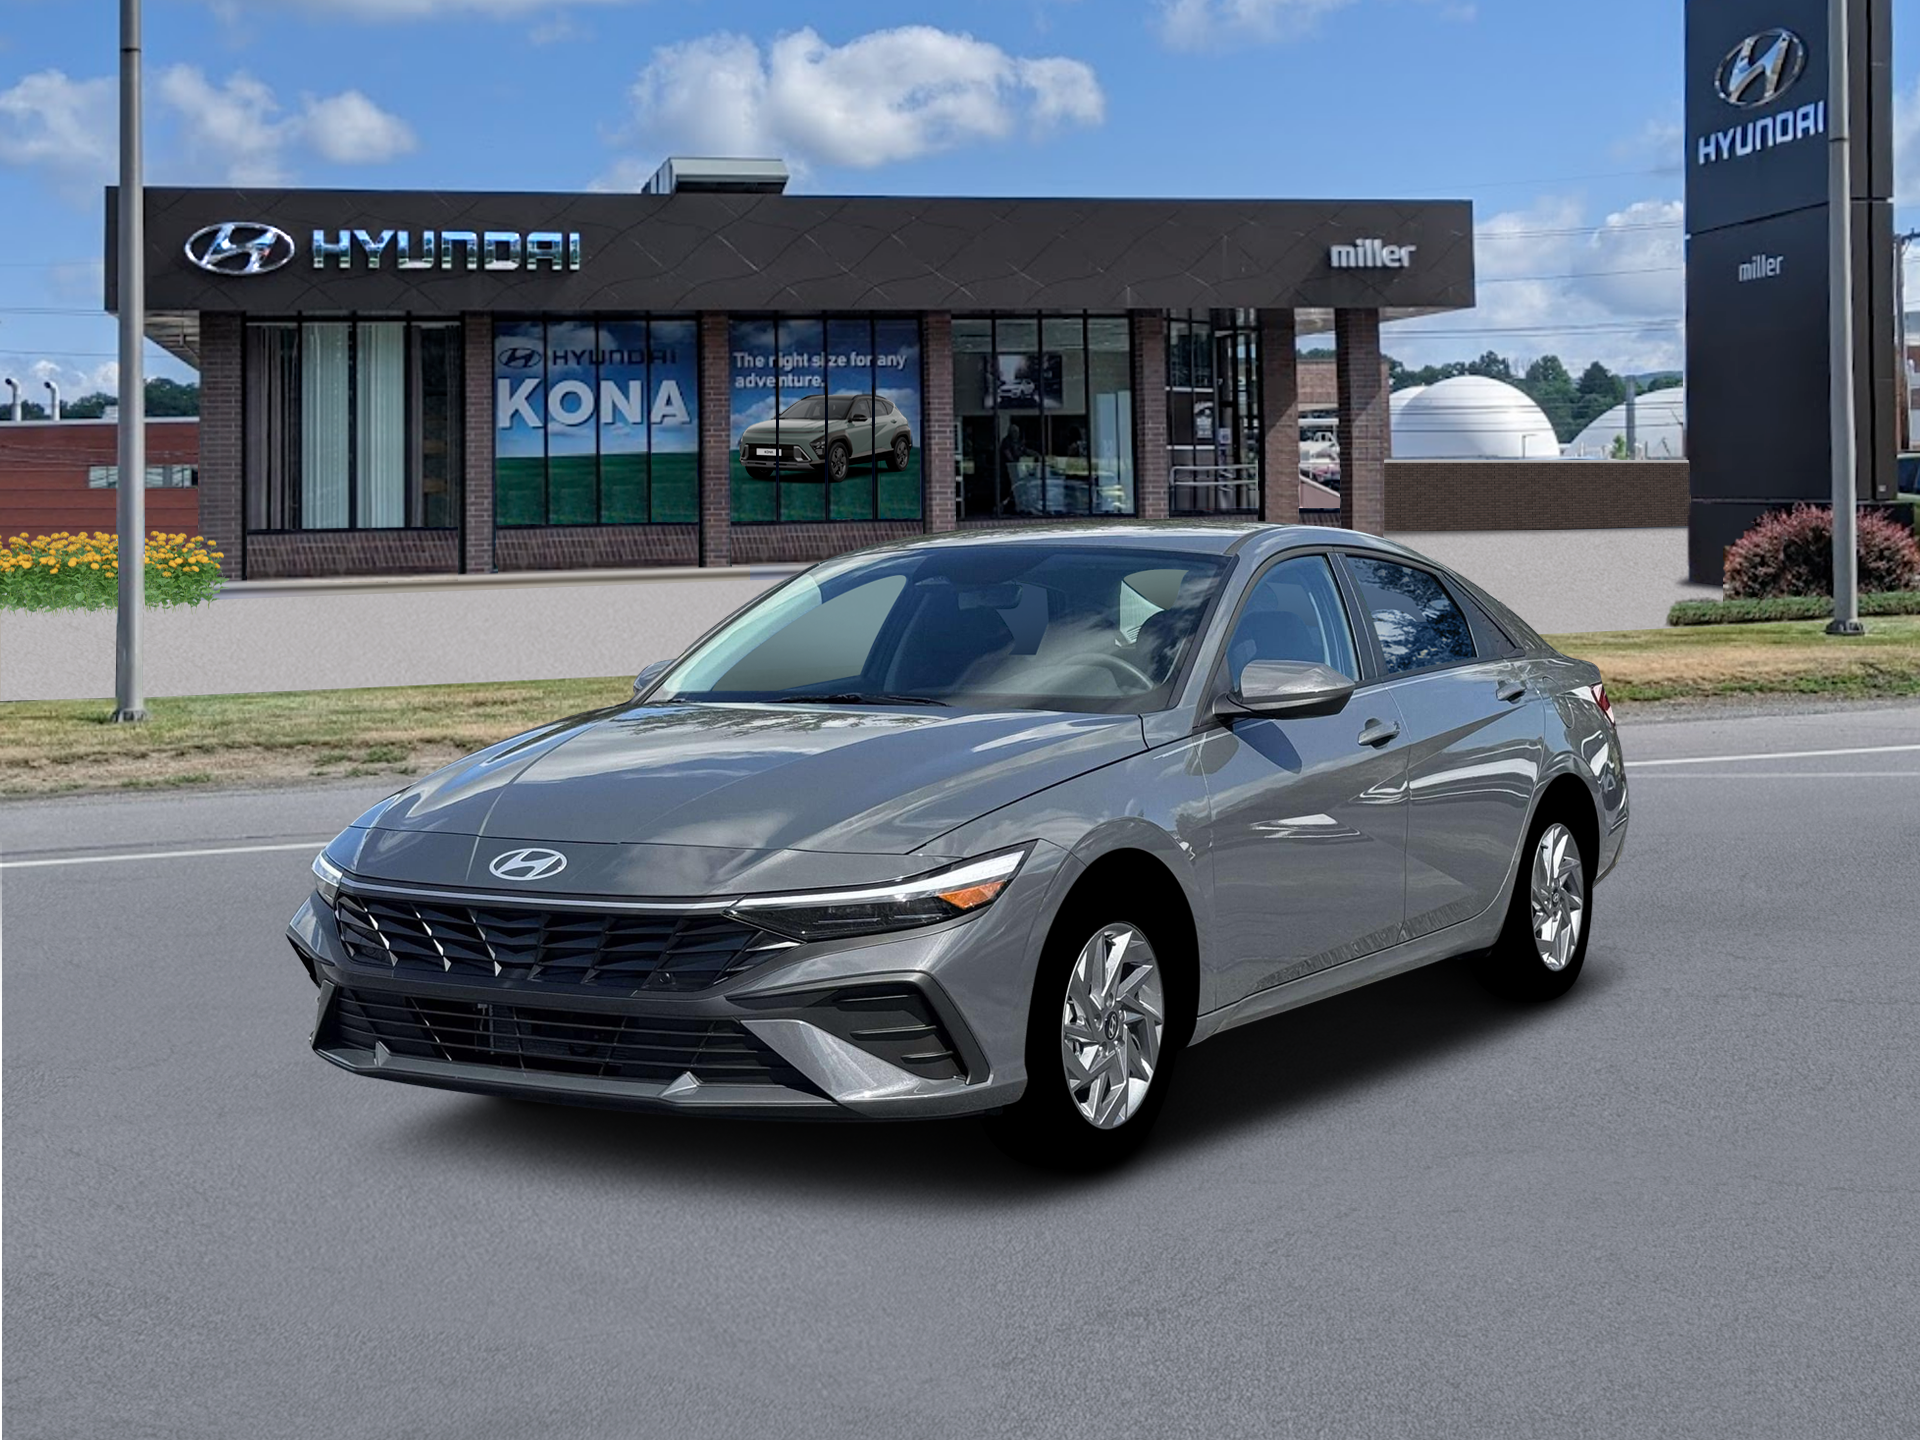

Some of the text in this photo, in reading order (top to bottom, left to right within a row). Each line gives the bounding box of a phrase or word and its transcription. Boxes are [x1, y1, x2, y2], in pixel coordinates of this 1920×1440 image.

[1698, 100, 1824, 165] HYUNDAI
[312, 229, 581, 270] HYUNDAI
[1330, 238, 1417, 267] miller
[1738, 254, 1784, 282] miller
[553, 349, 676, 365] HYUNDAI
[733, 351, 907, 371] The right size for any
[734, 374, 826, 388] adventure.
[497, 378, 692, 428] KONA
